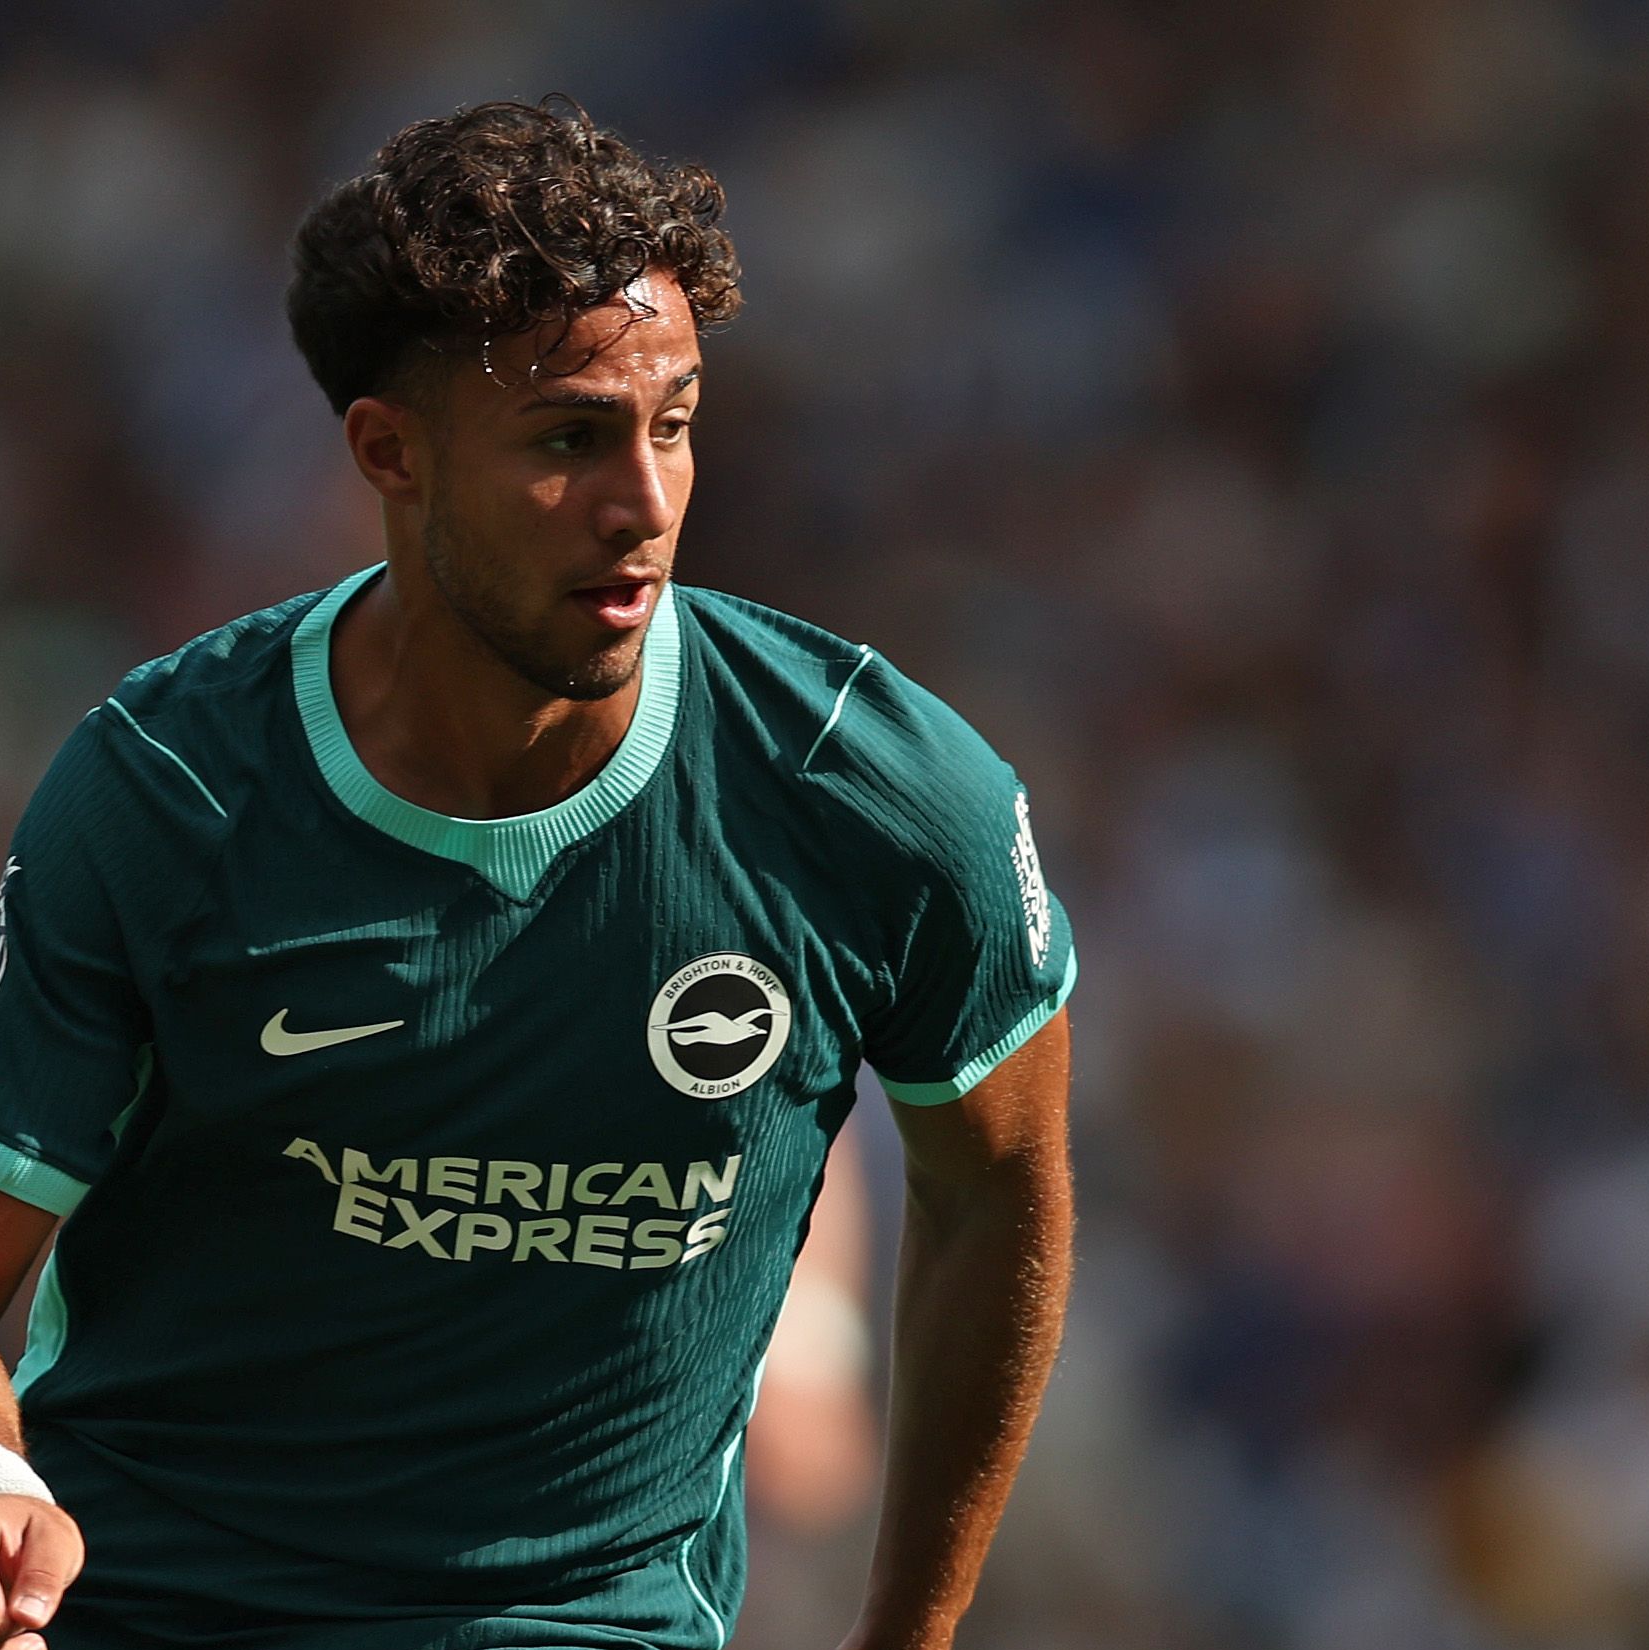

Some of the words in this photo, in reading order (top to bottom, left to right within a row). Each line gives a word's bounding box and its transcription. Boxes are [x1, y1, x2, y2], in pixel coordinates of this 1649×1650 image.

[664, 959, 731, 1000] BRIGHTON
[736, 960, 745, 972] &
[747, 964, 779, 995] HOVE
[689, 1078, 741, 1095] ALBION
[281, 1137, 742, 1211] AMERICAN
[333, 1184, 731, 1271] EXPRESS
